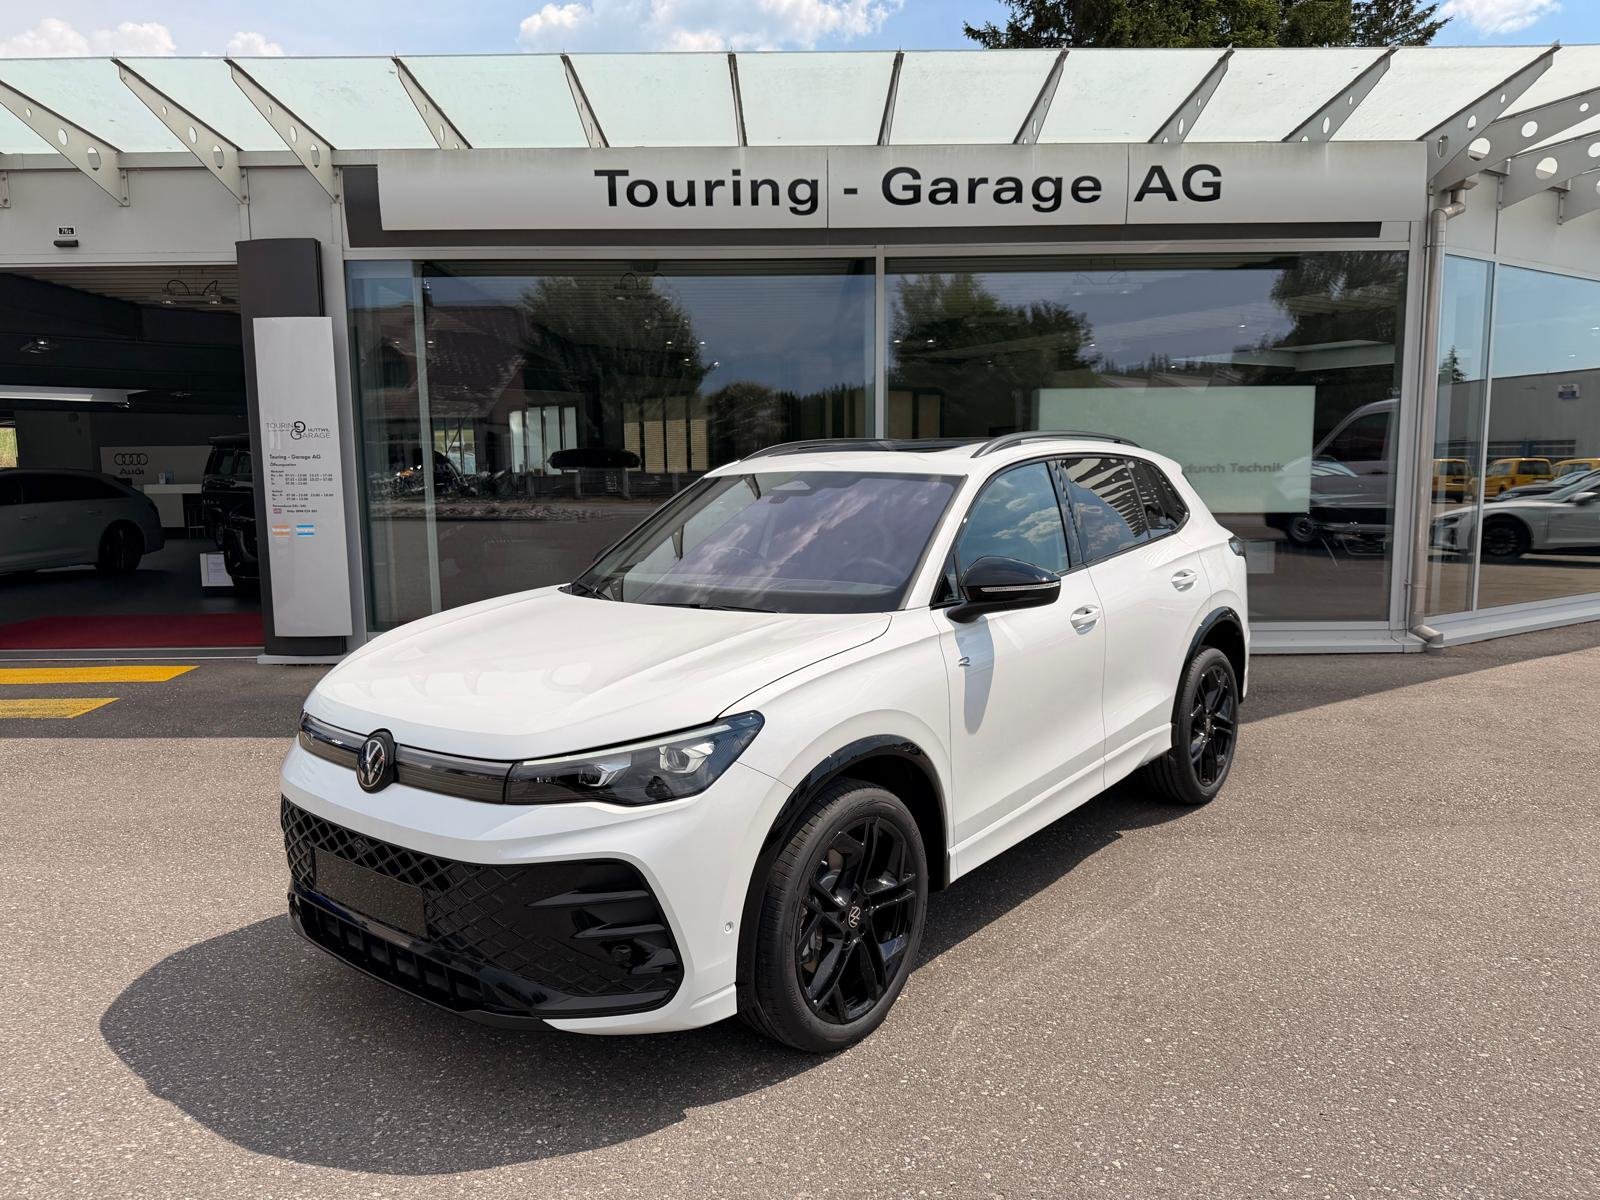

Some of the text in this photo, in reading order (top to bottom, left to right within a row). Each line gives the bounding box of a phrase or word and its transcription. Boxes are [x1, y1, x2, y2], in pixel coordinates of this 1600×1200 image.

[594, 169, 818, 216] Touring
[882, 167, 1101, 213] Garage
[1134, 164, 1221, 202] AG
[120, 467, 145, 475] Audi
[1183, 462, 1285, 474] durch Technik
